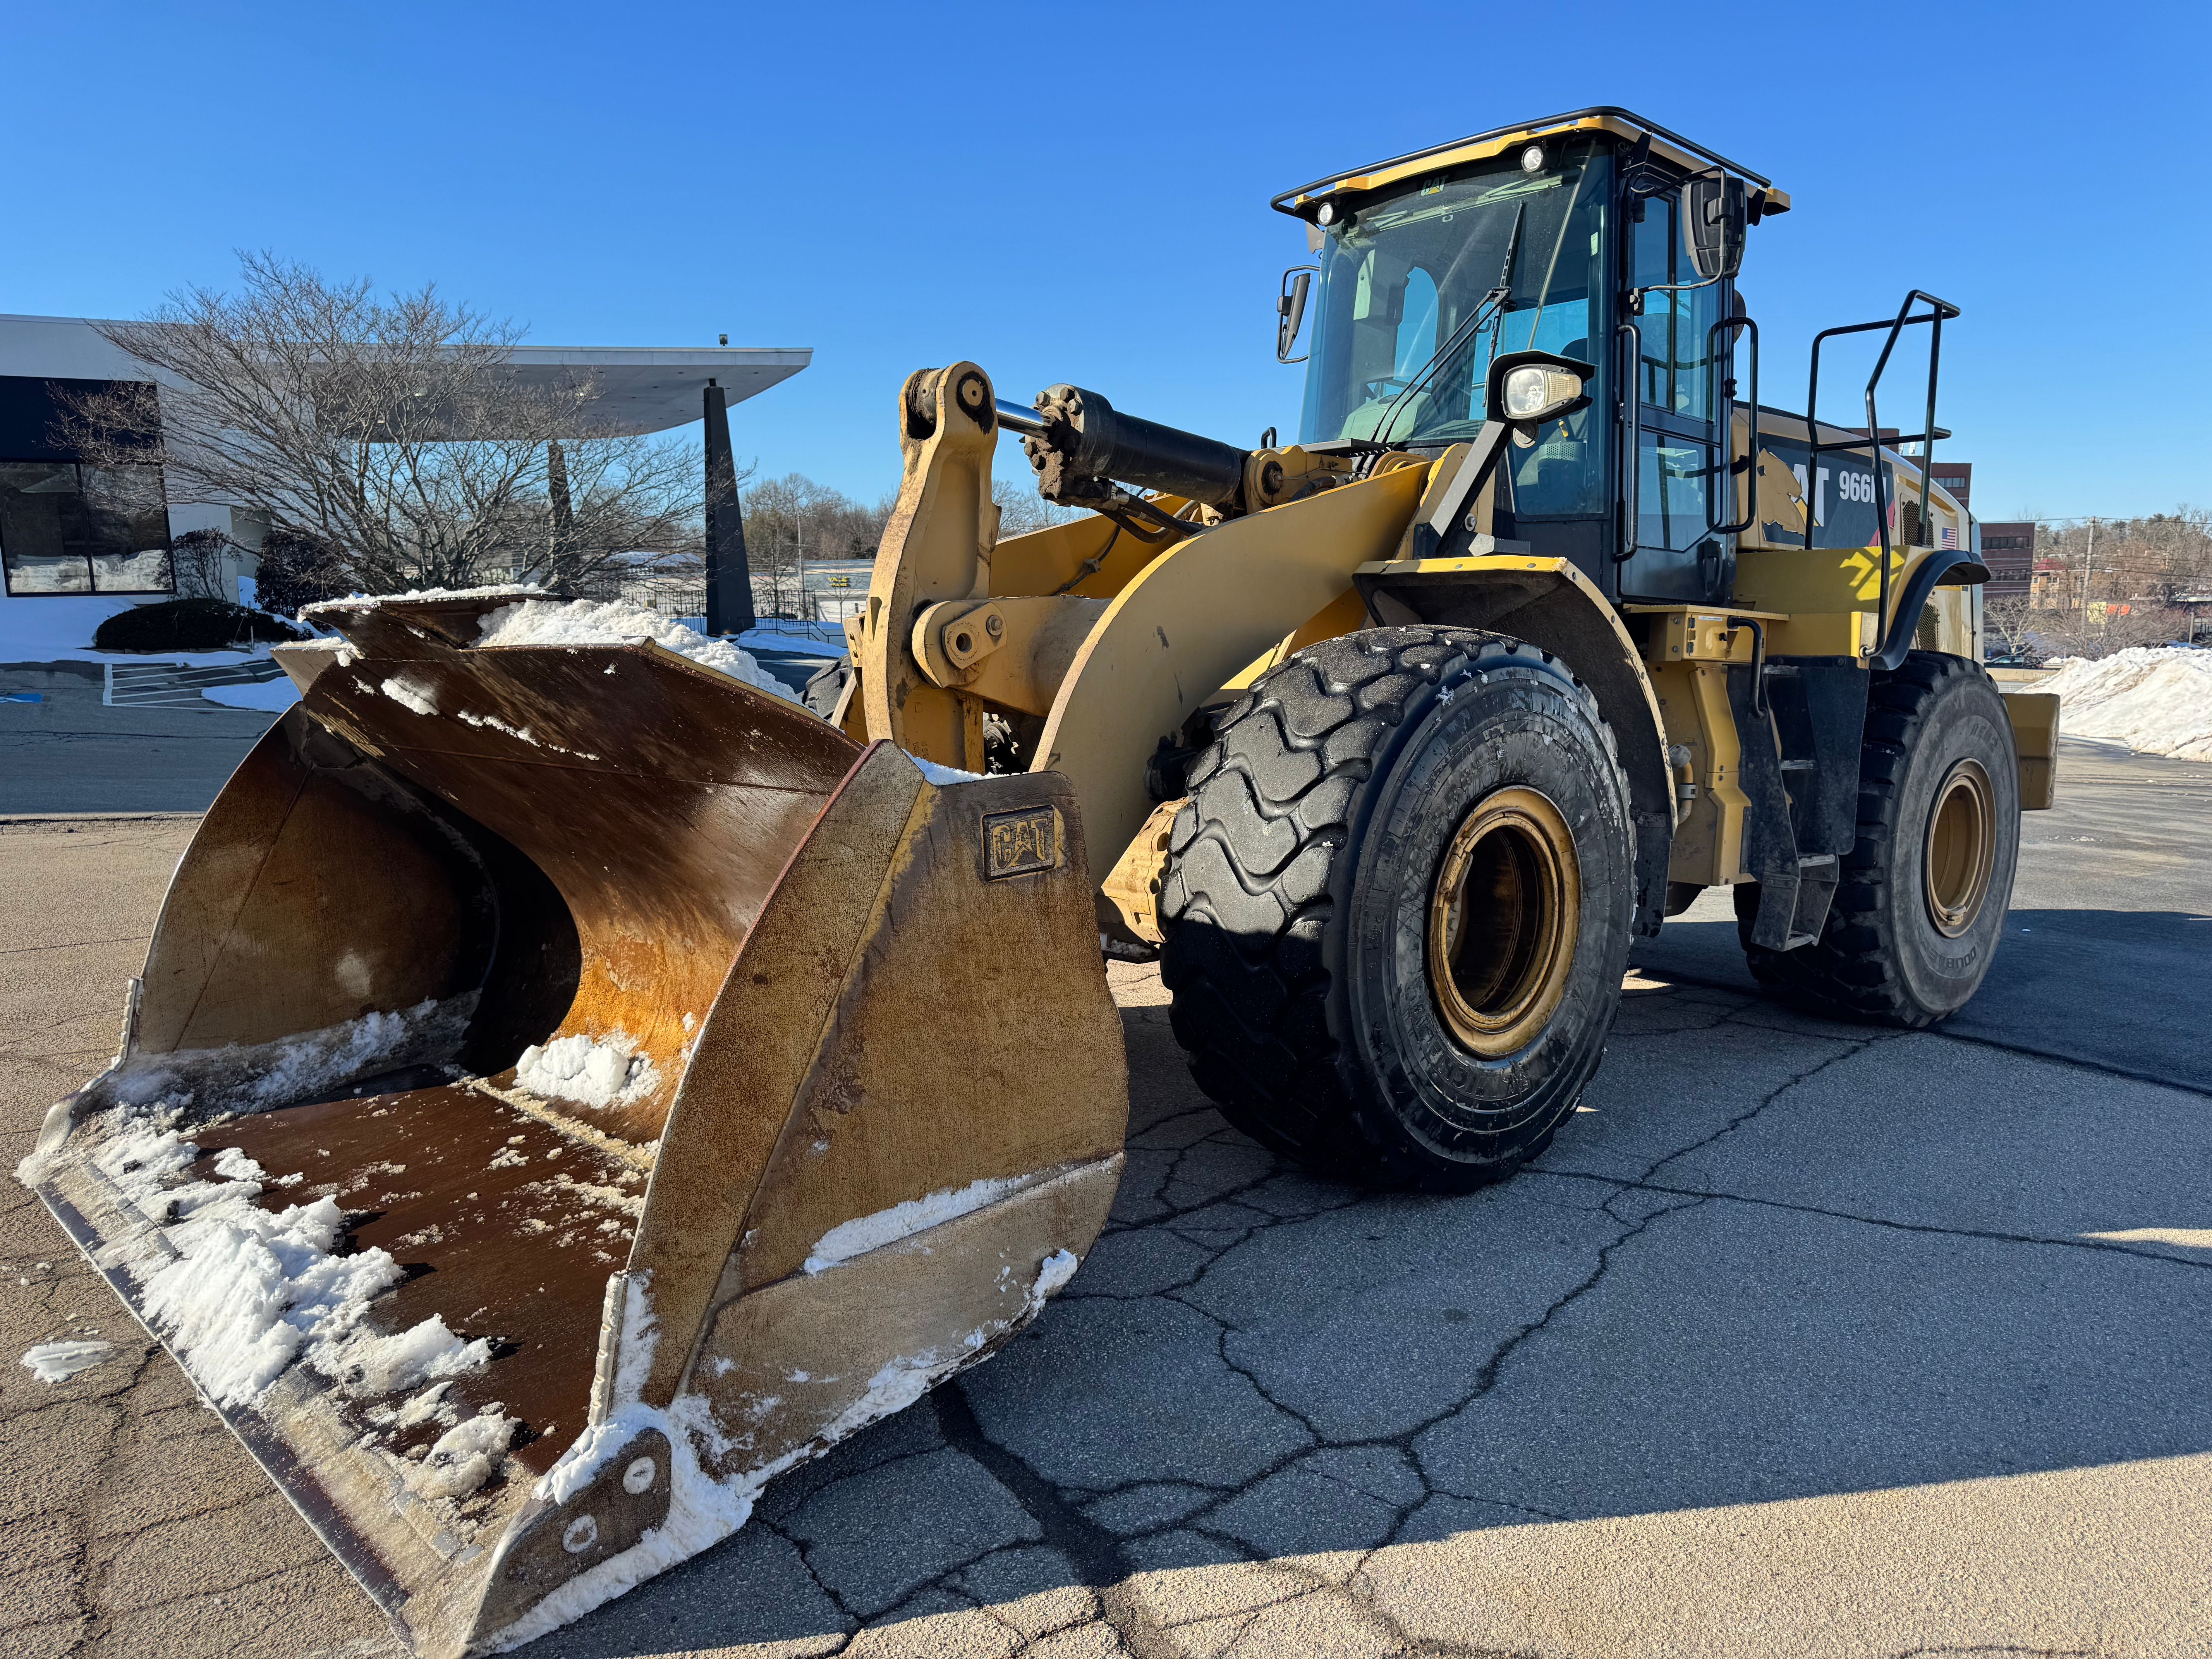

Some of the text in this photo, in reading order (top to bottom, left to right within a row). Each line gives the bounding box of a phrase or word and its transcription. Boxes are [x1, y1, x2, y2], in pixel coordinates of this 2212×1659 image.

[1420, 174, 1449, 196] CAT
[1790, 464, 1829, 527] AT
[993, 818, 1048, 869] CAT
